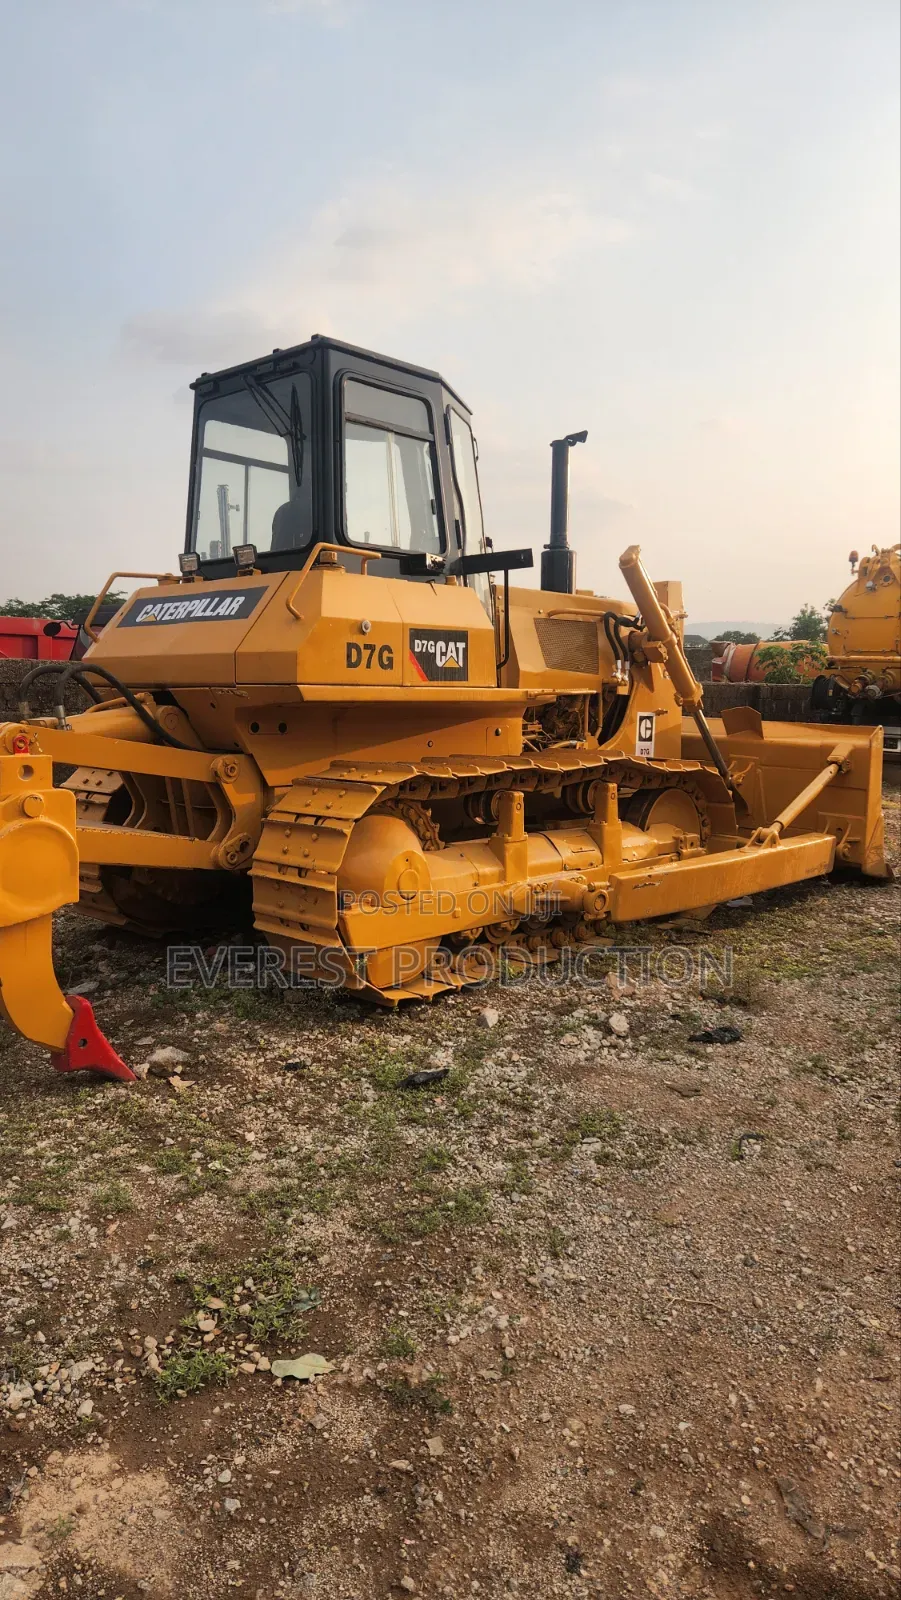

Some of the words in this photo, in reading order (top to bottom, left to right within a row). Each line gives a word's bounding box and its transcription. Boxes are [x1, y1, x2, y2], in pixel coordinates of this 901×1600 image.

[135, 596, 246, 623] CATERPILLAR
[346, 642, 394, 670] D7G
[414, 639, 436, 653] D7G
[435, 640, 466, 668] CAT
